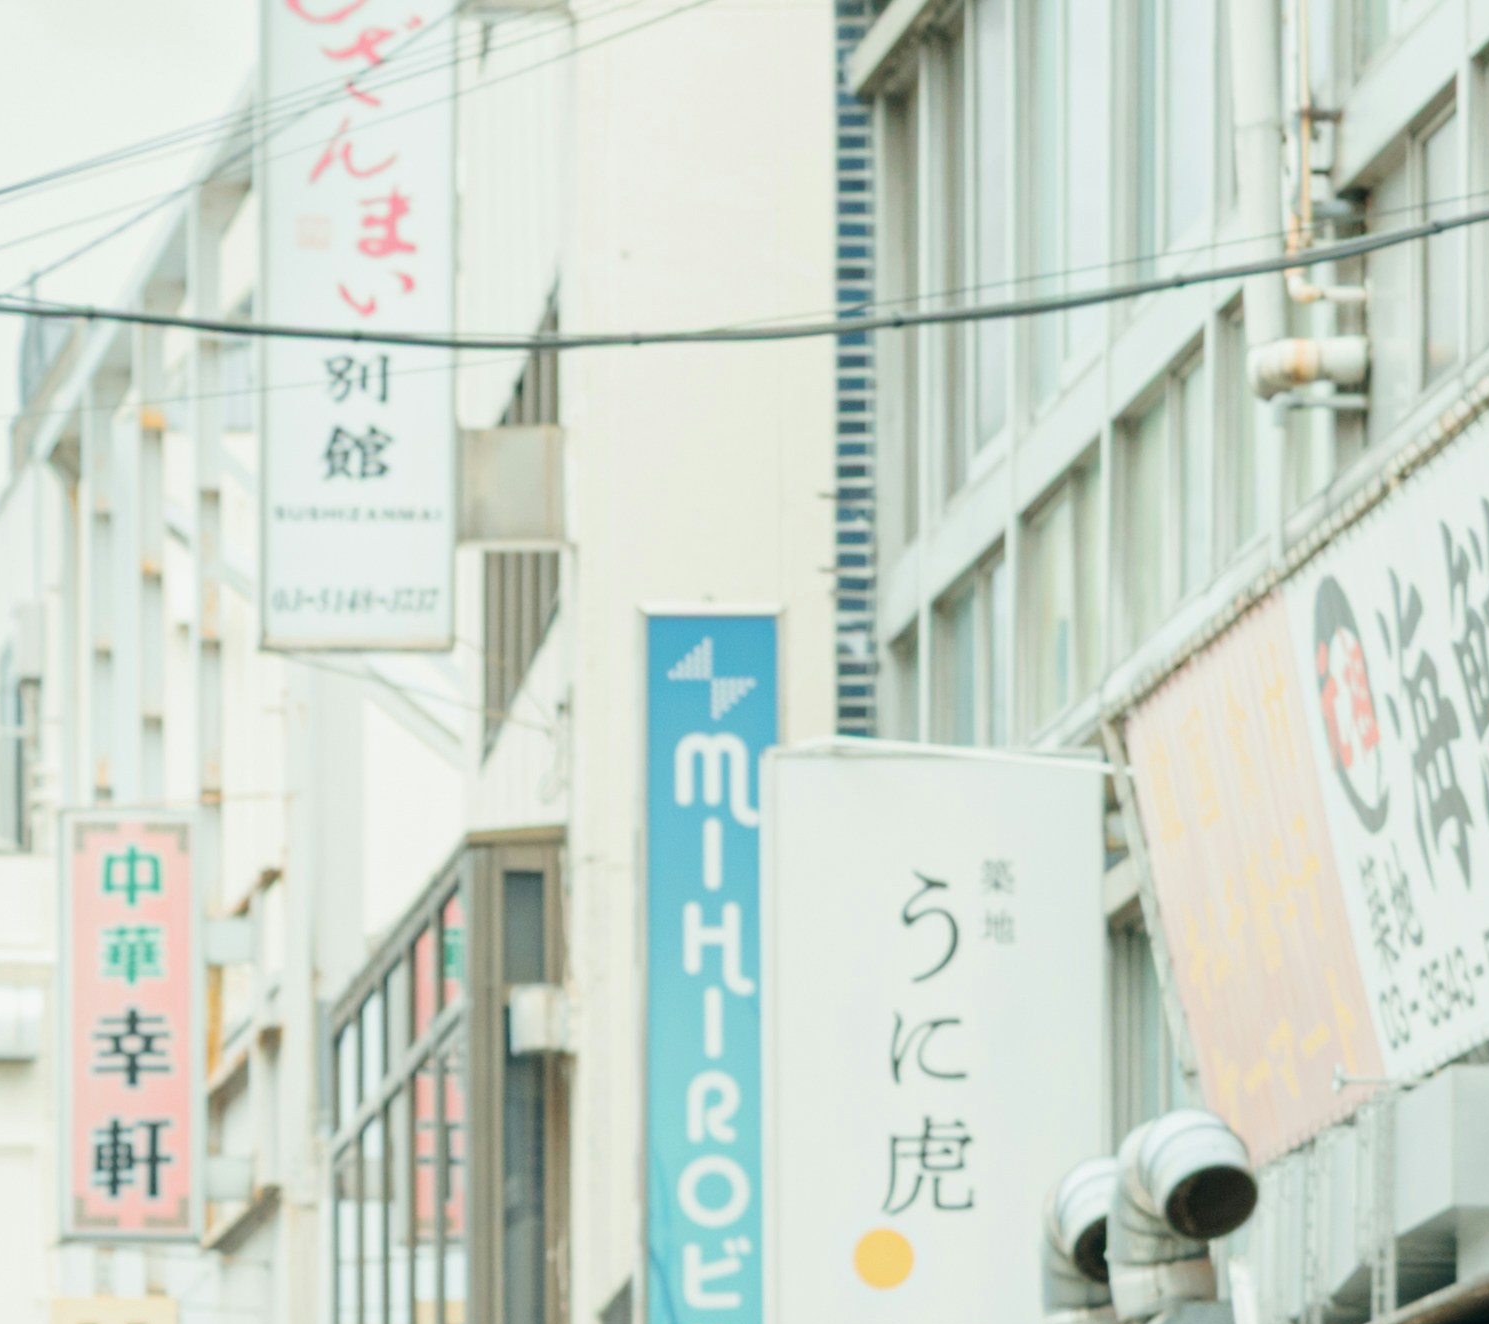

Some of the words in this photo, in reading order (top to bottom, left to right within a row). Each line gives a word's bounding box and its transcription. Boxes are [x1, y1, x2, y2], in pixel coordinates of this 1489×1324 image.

[285, 0, 422, 316] ざんまい
[883, 870, 975, 1216] うに虎
[981, 859, 1016, 944] 築地
